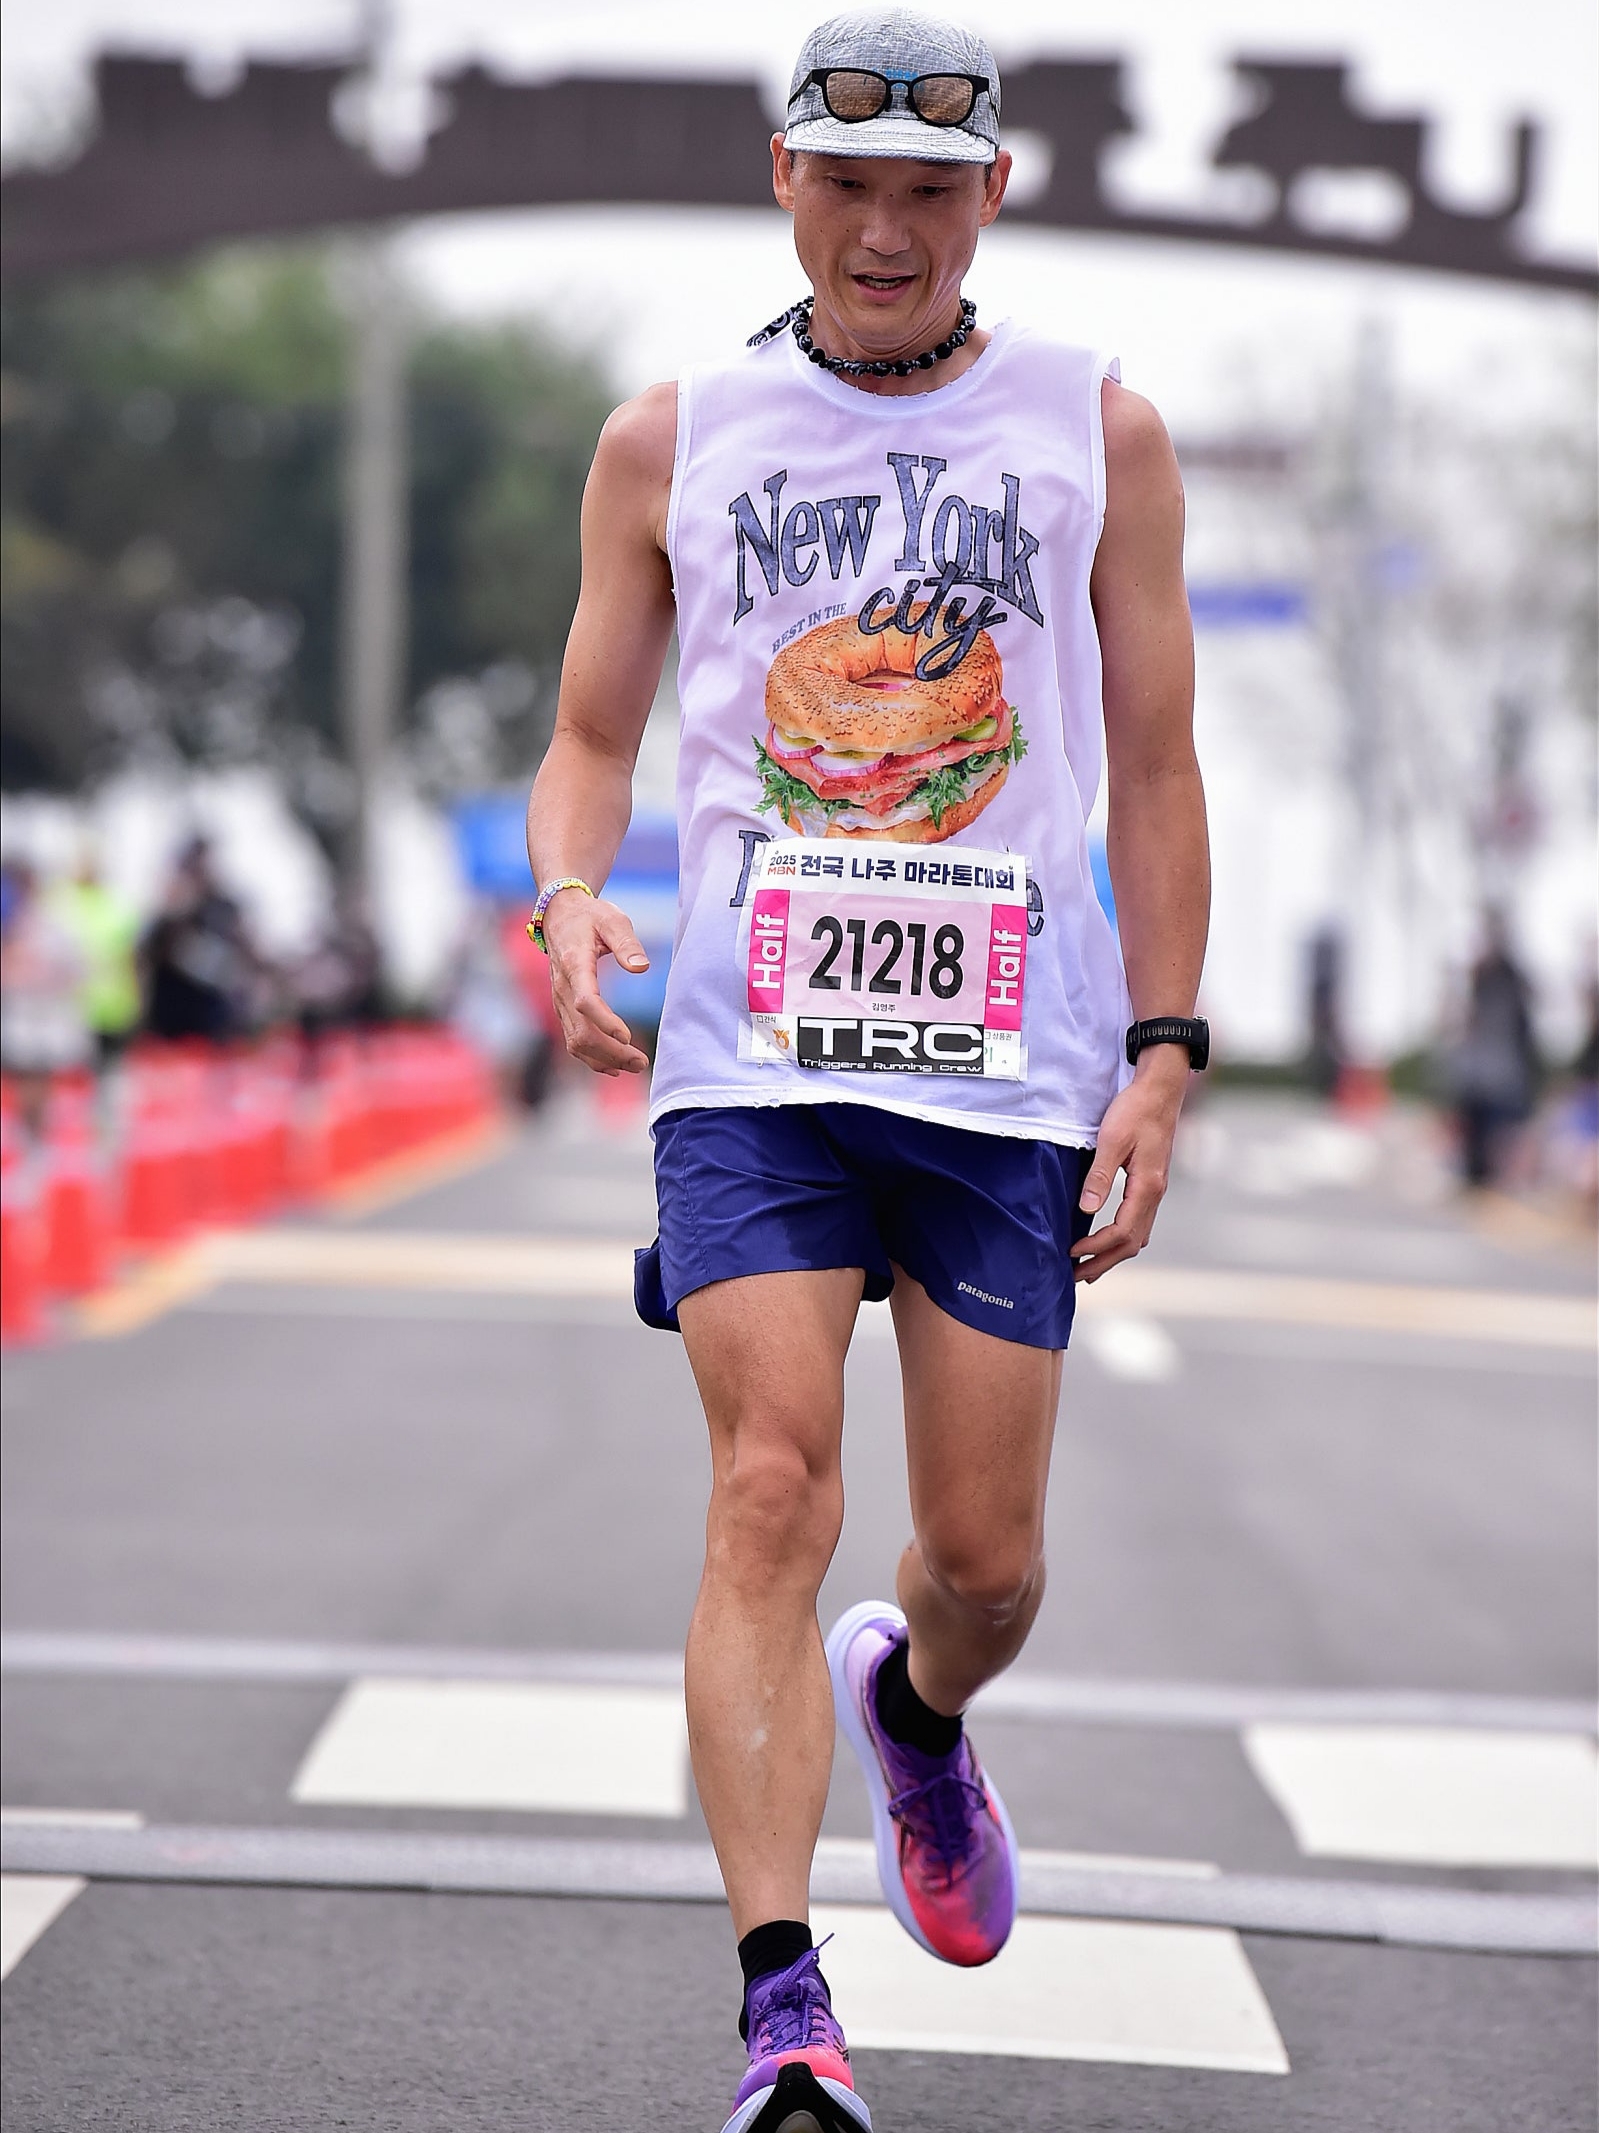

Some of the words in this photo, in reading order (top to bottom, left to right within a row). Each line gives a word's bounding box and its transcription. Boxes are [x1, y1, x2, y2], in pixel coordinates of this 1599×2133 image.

[729, 469, 881, 626] New
[887, 452, 1044, 628] York
[772, 618, 806, 654] BEST
[807, 609, 822, 627] IN
[824, 602, 847, 619] THE
[858, 561, 1008, 682] city
[767, 866, 797, 876] MBN
[769, 854, 797, 866] 2025
[800, 855, 844, 878] 전국
[851, 858, 897, 881] 나주
[904, 861, 1015, 891] 마라톤대회
[752, 913, 785, 989] Half
[809, 915, 965, 1000] 21218
[989, 929, 1022, 1006] Half
[800, 1018, 983, 1061] TRC
[992, 1031, 1013, 1041] 상품권
[801, 1058, 867, 1071] Triggers
[873, 1061, 933, 1073] Running
[957, 1281, 1015, 1309] patagonia
